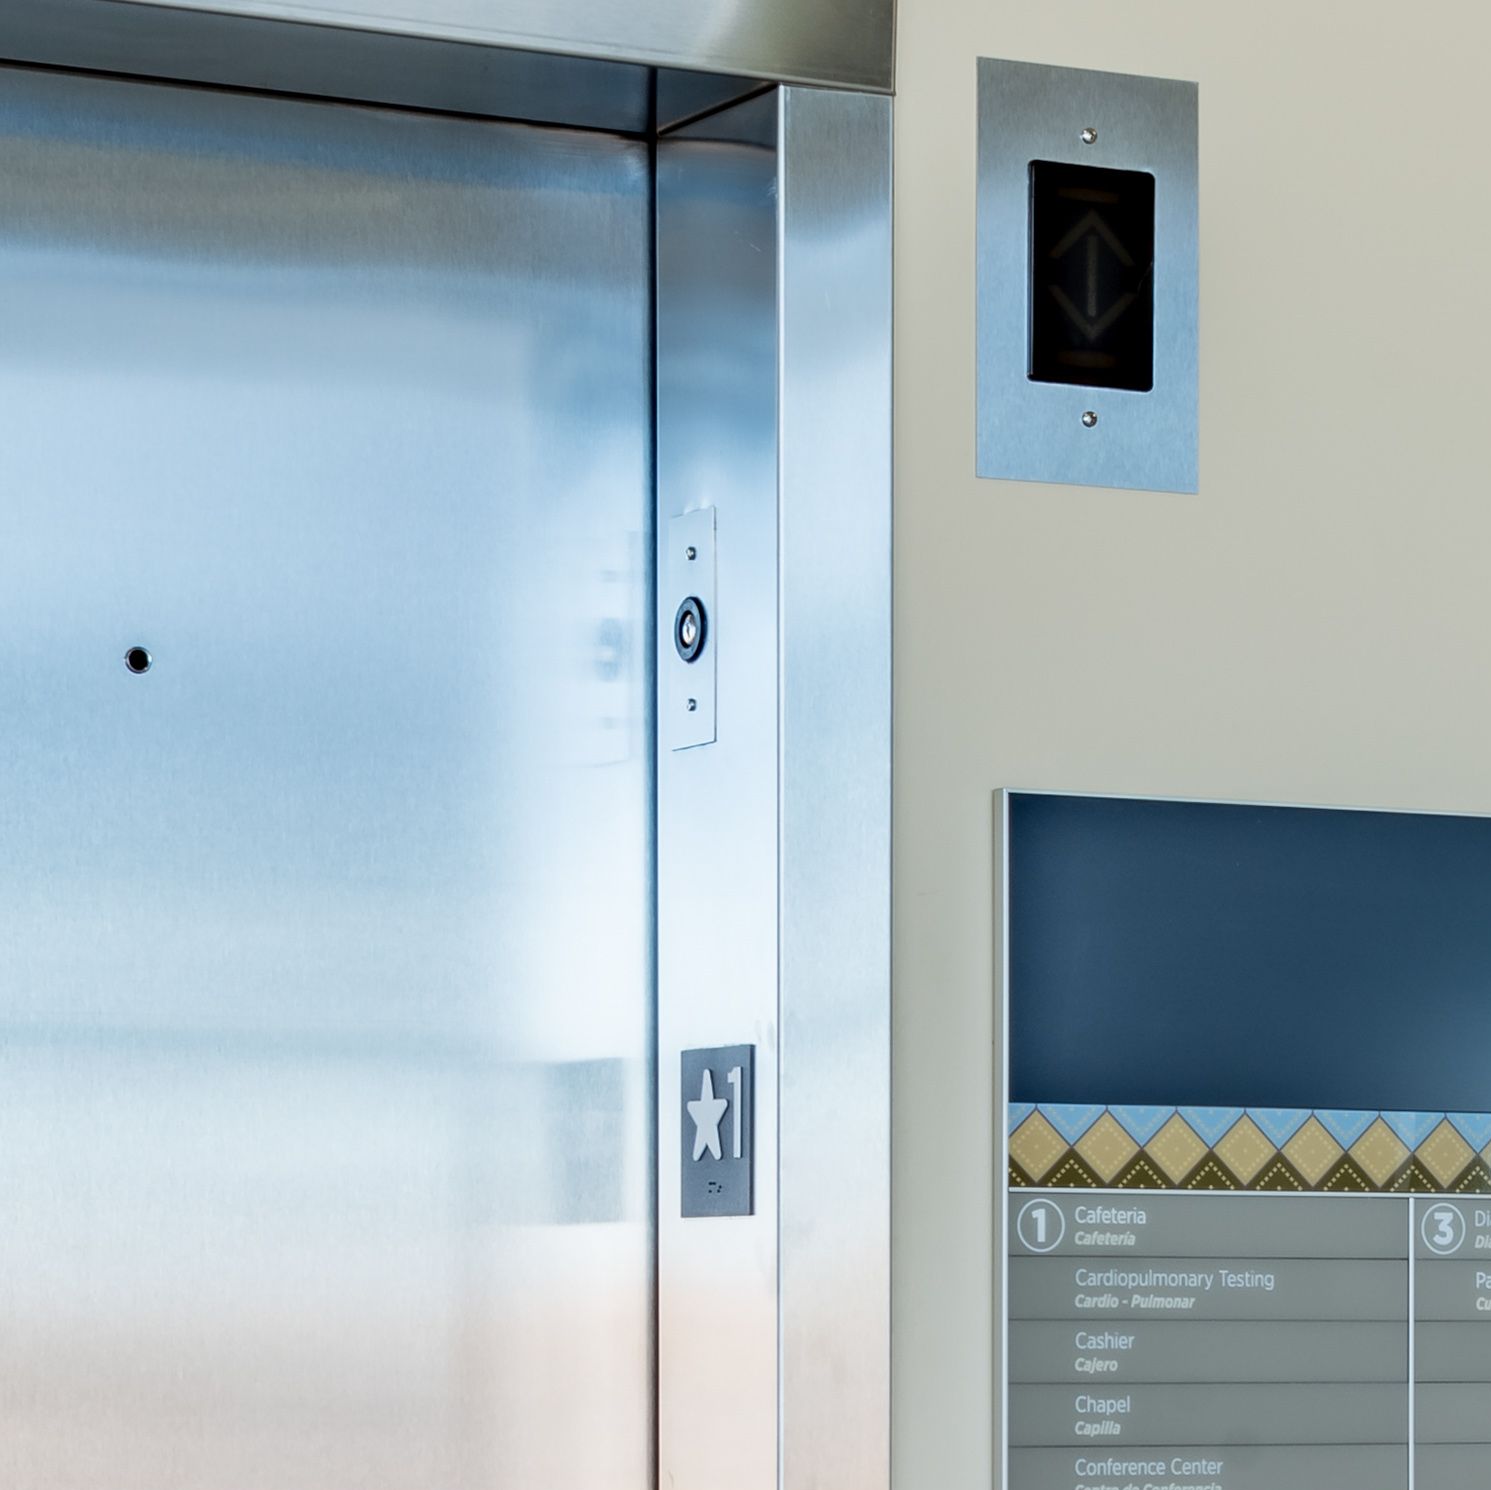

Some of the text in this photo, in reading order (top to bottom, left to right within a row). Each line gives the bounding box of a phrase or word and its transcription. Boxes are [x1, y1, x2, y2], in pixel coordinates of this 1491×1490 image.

[728, 1066, 742, 1159] 1
[1075, 1206, 1146, 1224] Cafeteria
[1031, 1208, 1045, 1243] 1
[1433, 1212, 1453, 1245] 3
[1076, 1269, 1274, 1290] Cardiopulmonary Testing
[1075, 1294, 1119, 1308] Cardio
[1131, 1294, 1195, 1308] Pulmonar
[1076, 1332, 1135, 1349] Cashier
[1075, 1357, 1118, 1373] Cajero
[1075, 1396, 1130, 1415] Chapel
[1075, 1458, 1223, 1476] Conference Center
